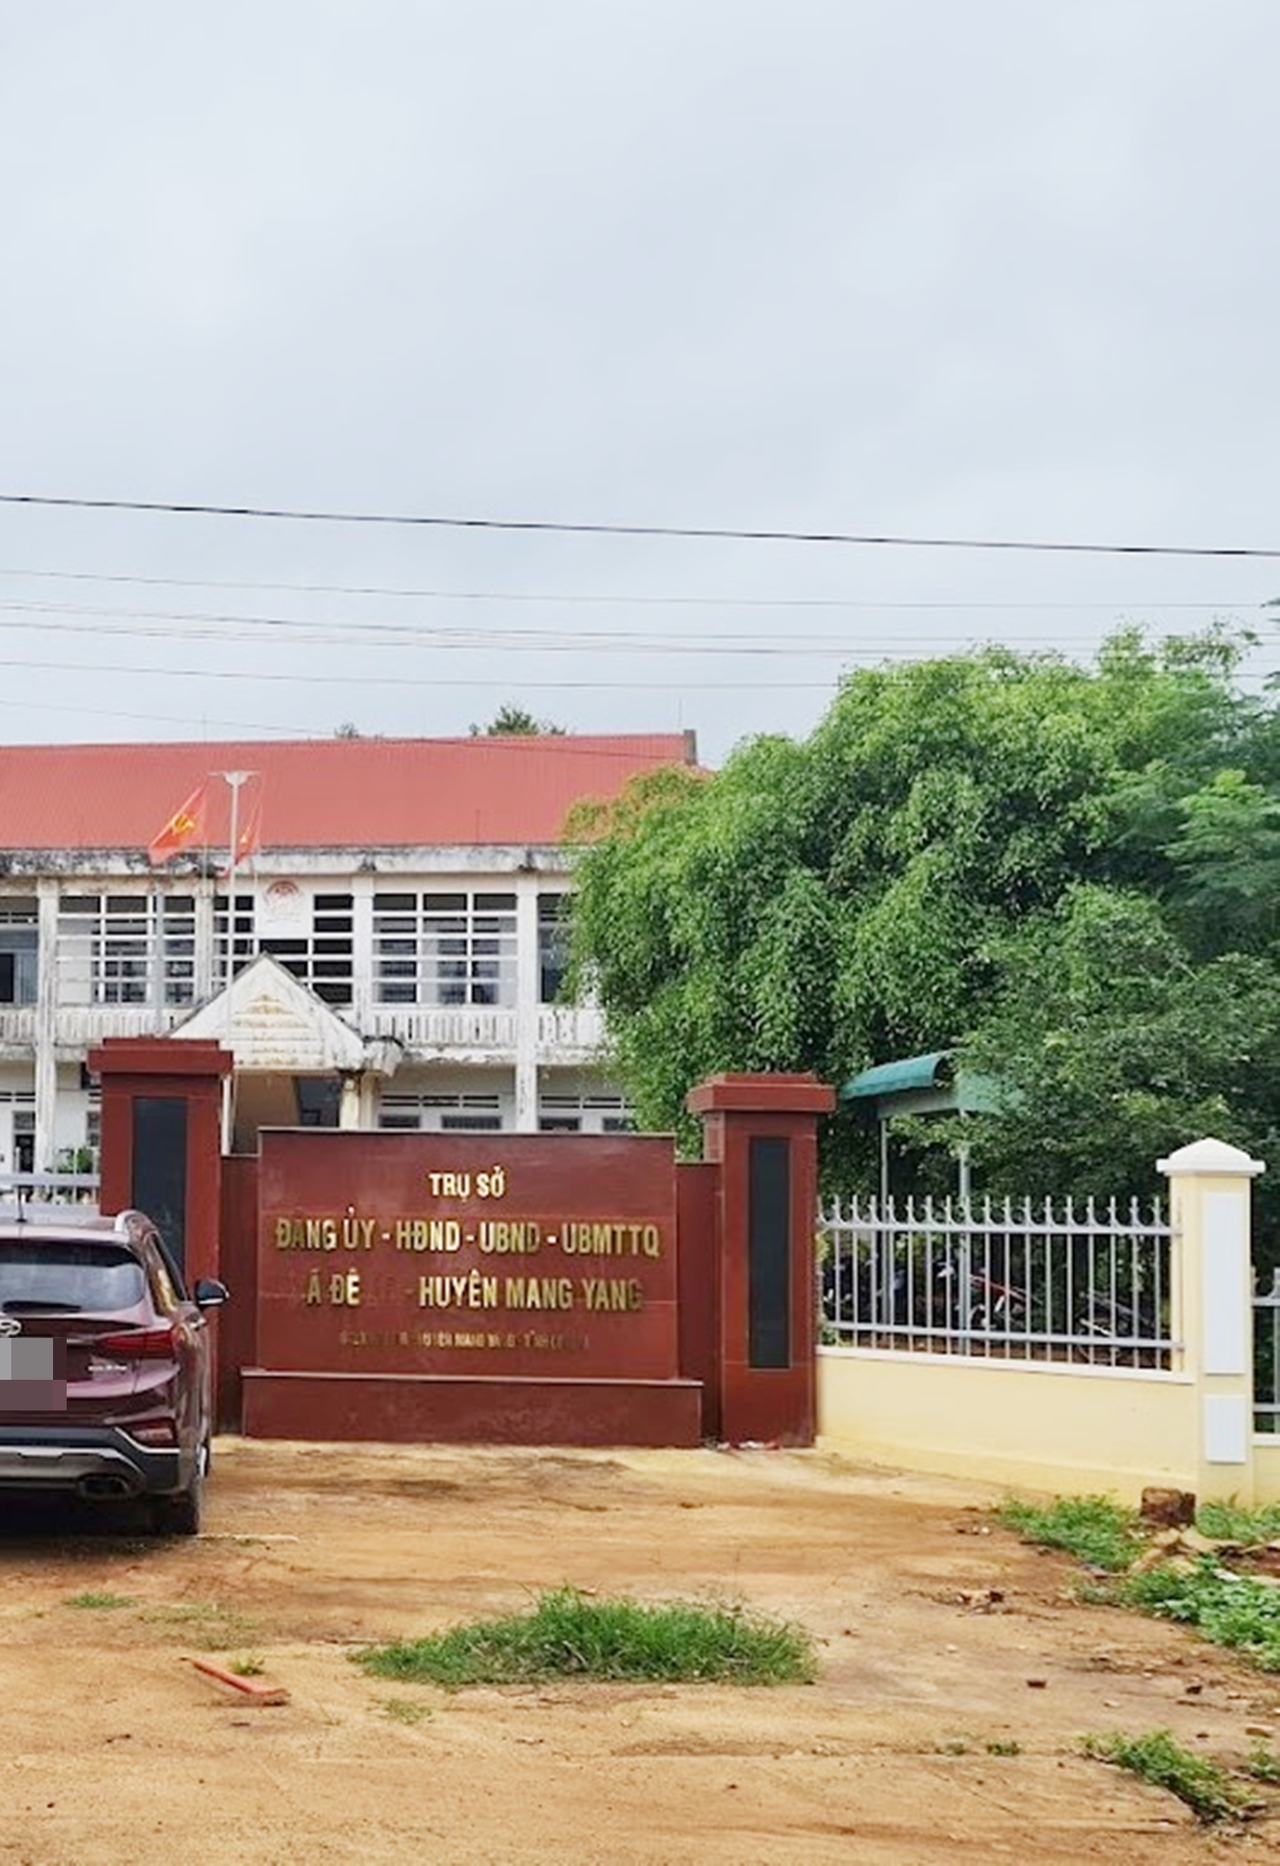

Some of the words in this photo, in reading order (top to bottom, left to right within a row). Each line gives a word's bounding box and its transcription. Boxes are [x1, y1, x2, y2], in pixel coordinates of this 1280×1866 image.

[428, 1172, 470, 1202] TRỤ
[476, 1165, 505, 1197] SỞ
[343, 1206, 376, 1249] ỦY
[396, 1220, 460, 1251] HĐND
[480, 1222, 540, 1252] UBND
[562, 1222, 660, 1256] UBMTTQ
